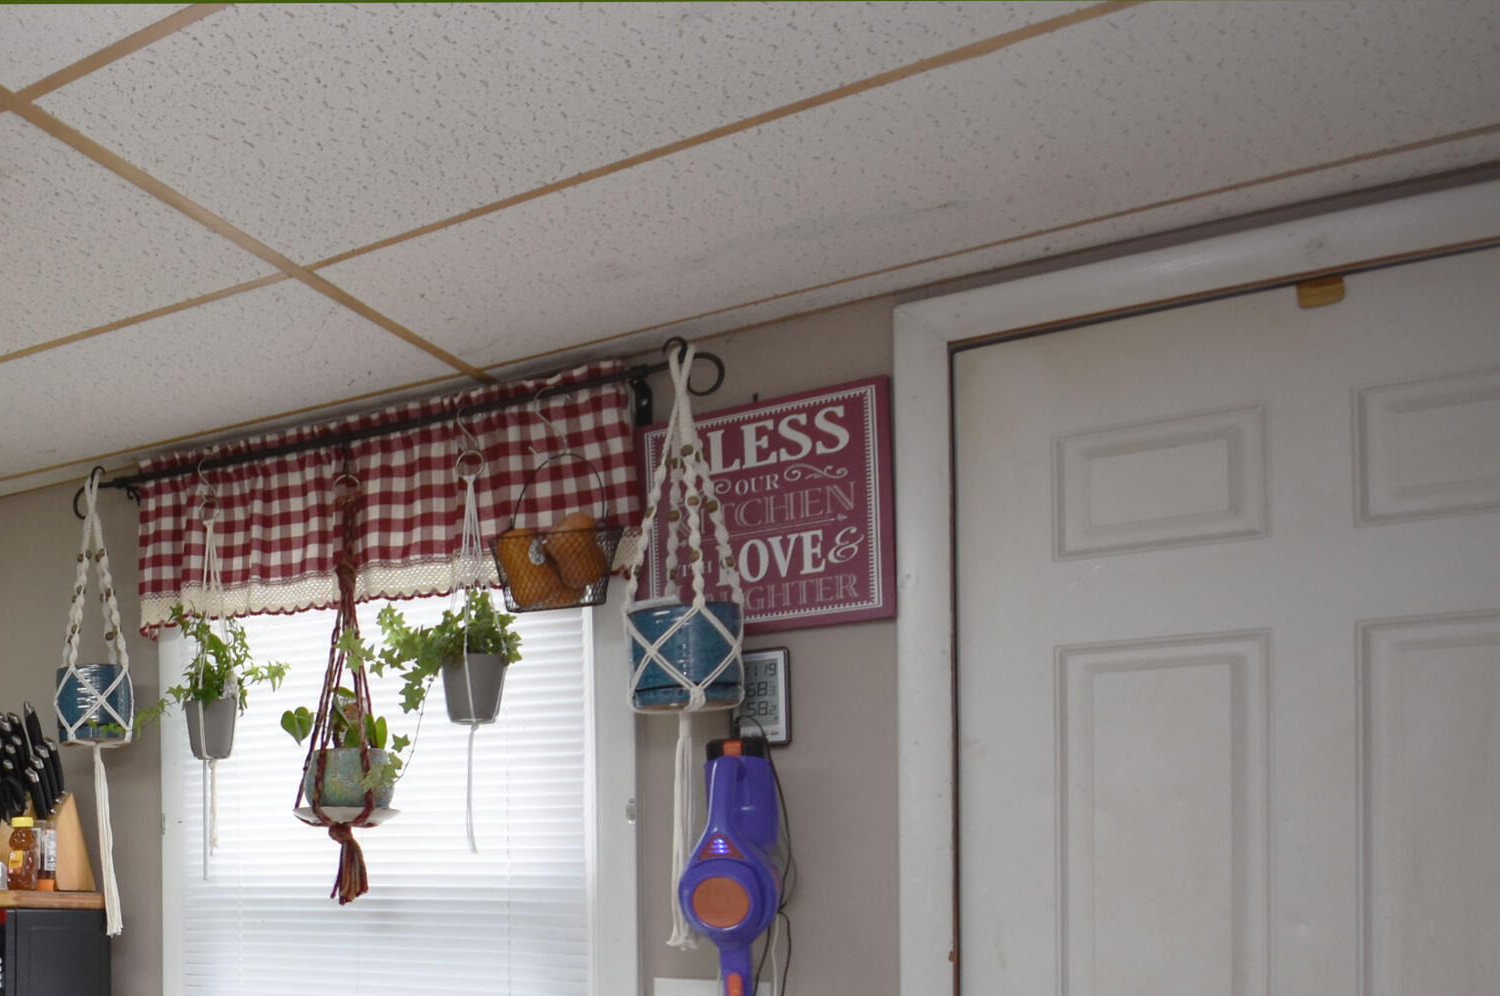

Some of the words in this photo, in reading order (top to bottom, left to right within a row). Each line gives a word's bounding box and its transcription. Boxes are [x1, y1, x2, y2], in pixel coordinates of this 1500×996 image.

[705, 405, 851, 475] LESS
[735, 474, 780, 496] OUR
[828, 526, 865, 564] &
